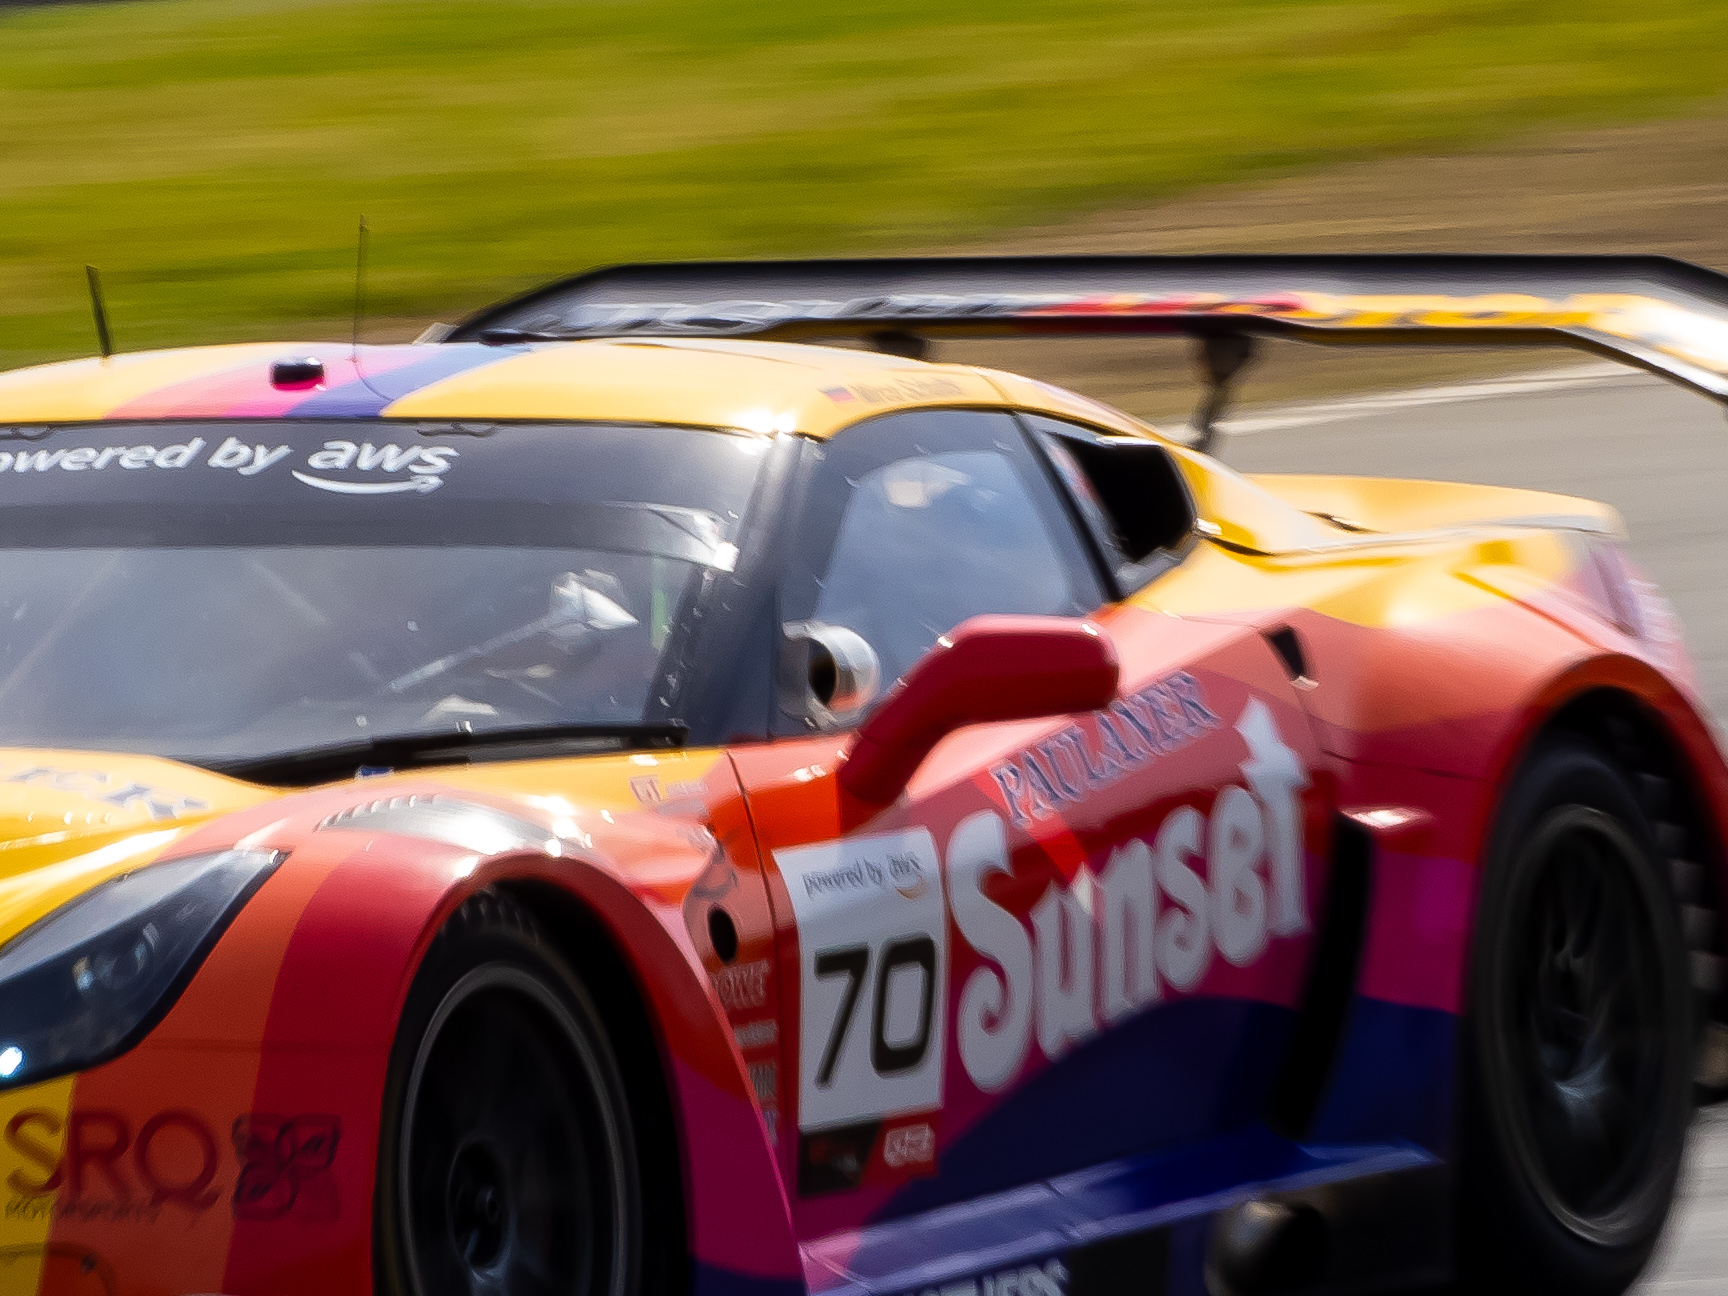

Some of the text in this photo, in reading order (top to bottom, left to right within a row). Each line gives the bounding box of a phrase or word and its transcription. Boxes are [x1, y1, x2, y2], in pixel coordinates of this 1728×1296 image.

[208, 437, 293, 476] by
[307, 439, 461, 476] aws
[802, 859, 864, 899] powered
[947, 696, 1311, 1094] Sunset
[815, 933, 936, 1090] 70
[3, 1108, 218, 1207] SRO
